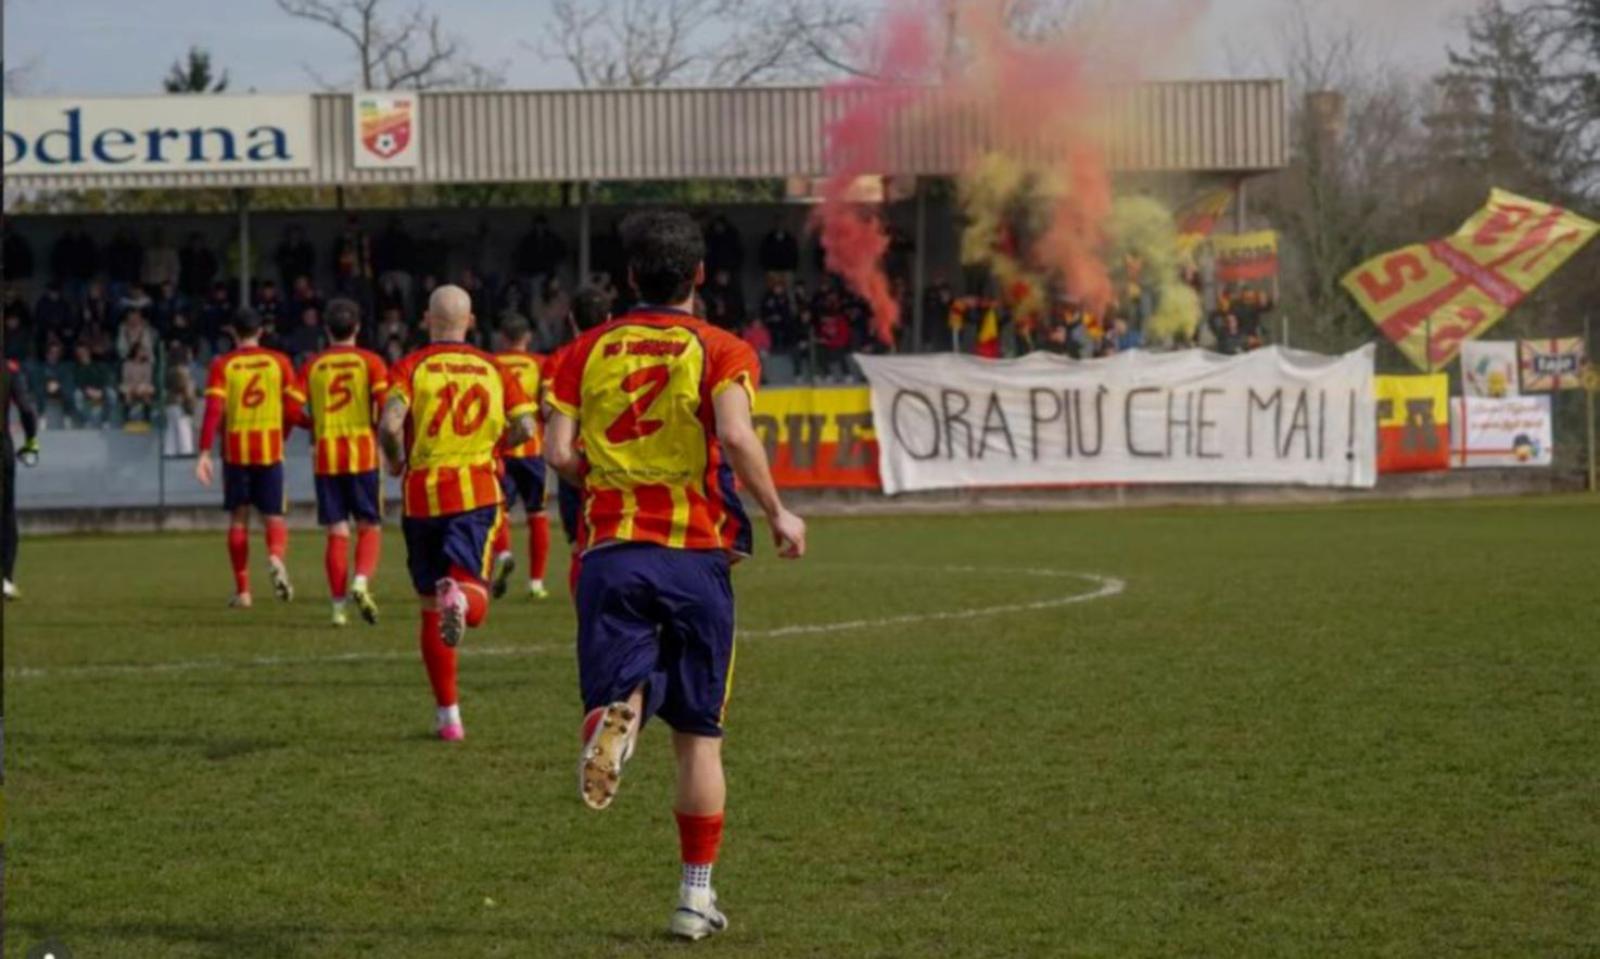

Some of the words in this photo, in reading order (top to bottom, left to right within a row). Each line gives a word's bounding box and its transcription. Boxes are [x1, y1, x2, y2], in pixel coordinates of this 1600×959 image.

[240, 374, 266, 409] 6
[326, 372, 354, 414] 5
[427, 380, 490, 438] 10
[604, 363, 671, 445] 2
[891, 388, 1018, 461] ORA
[1124, 387, 1225, 459] CHE
[1246, 386, 1325, 461] MAI
